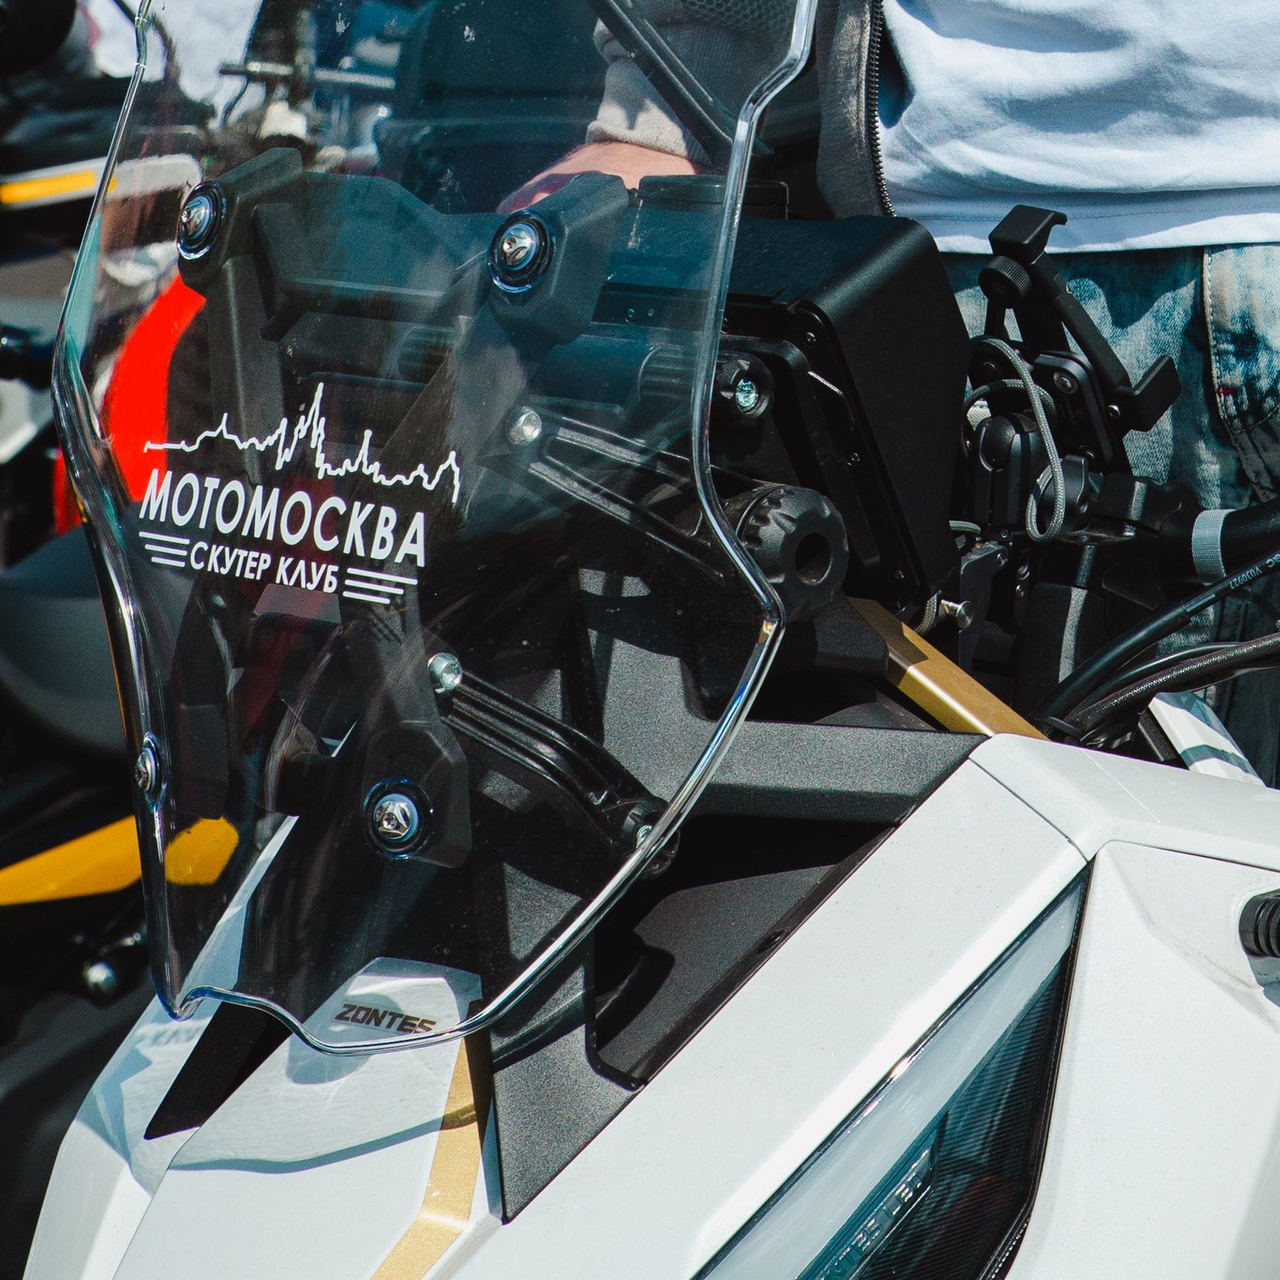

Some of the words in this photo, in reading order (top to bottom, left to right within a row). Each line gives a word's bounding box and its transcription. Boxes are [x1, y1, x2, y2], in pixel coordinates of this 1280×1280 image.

[138, 468, 426, 568] МОТОМОСКВА
[189, 540, 271, 581] СКУТЕР
[275, 548, 339, 594] КЛУБ
[1230, 566, 1262, 589] V030927
[335, 1004, 436, 1033] ZONTES
